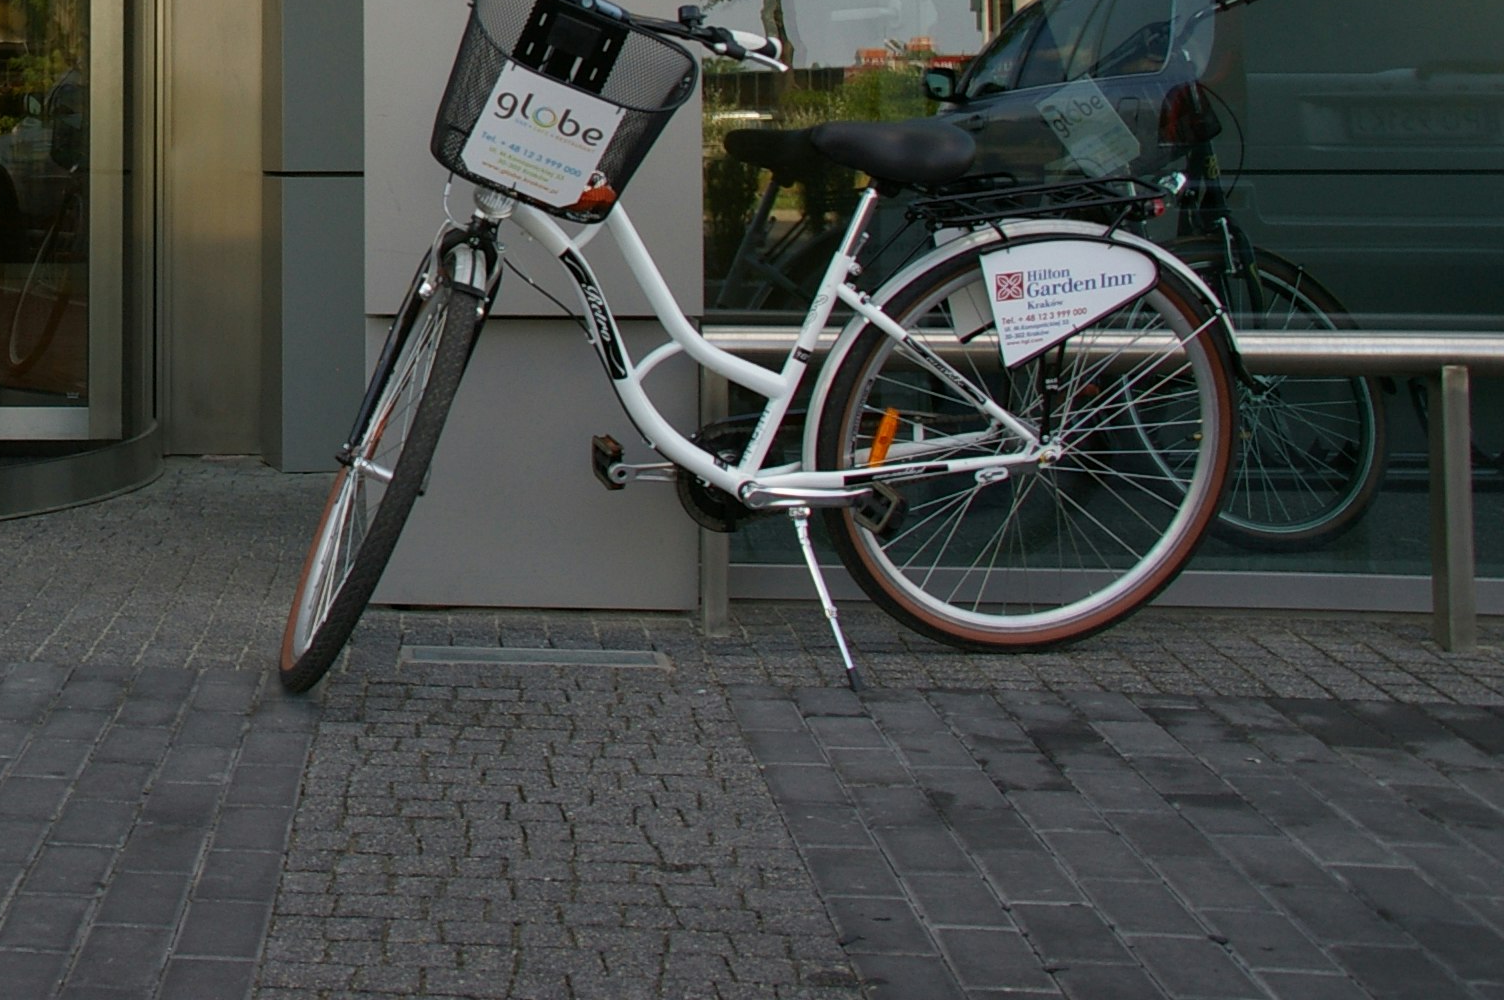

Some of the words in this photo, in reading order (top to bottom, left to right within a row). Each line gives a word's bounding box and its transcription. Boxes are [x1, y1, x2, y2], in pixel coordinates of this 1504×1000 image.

[494, 91, 604, 147] globe
[508, 143, 521, 153] 48
[523, 149, 535, 159] 12
[544, 158, 563, 169] 999
[563, 165, 583, 178] 000
[1026, 278, 1097, 298] Garden
[1100, 272, 1134, 289] Inn
[1027, 268, 1071, 283] Hilton
[581, 283, 612, 342] Retro
[1002, 316, 1016, 325] Tel.
[1025, 313, 1036, 322] 48
[1038, 312, 1048, 320] 12
[1056, 309, 1071, 318] 999
[1072, 307, 1088, 317] 000
[1027, 299, 1064, 311] Kraków
